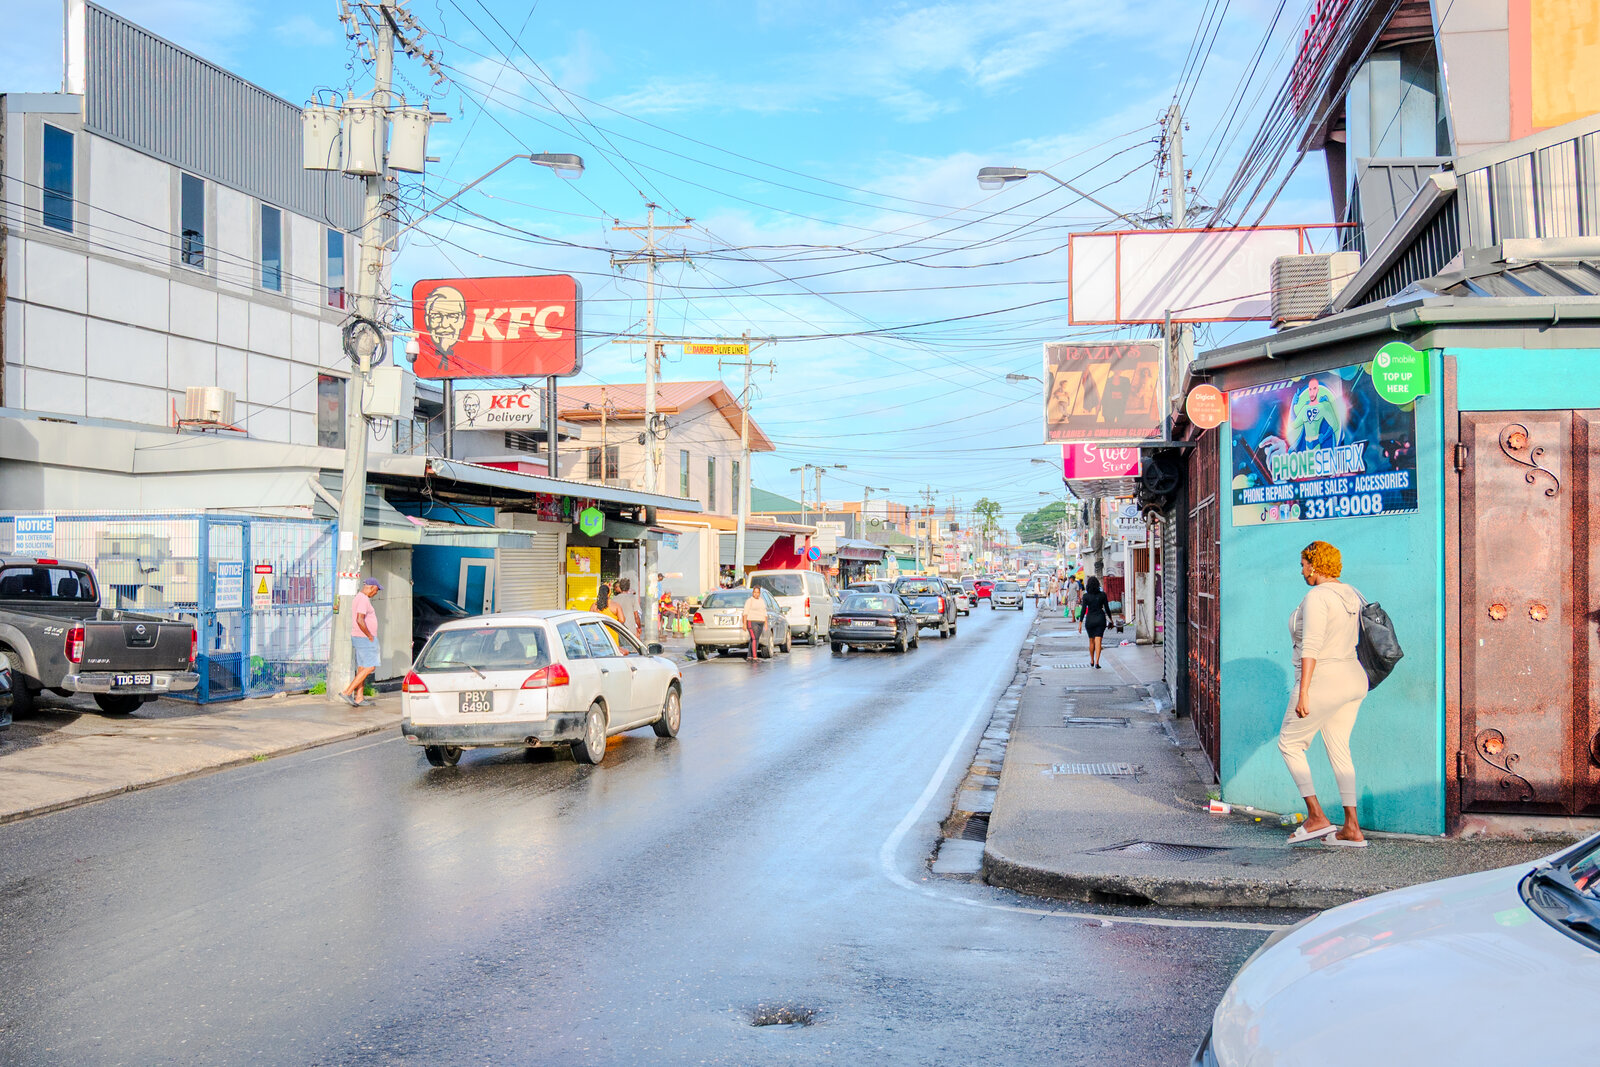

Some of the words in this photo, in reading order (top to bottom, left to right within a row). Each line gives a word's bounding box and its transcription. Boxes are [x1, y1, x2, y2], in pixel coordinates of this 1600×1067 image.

[468, 306, 565, 341] KFC
[693, 346, 714, 354] DANGER
[489, 394, 531, 410] KFC
[487, 412, 533, 424] Delivery
[1102, 462, 1133, 473] Store
[1243, 486, 1265, 503] PHONE
[1265, 484, 1294, 500] REPAIRS
[1299, 481, 1324, 498] PHONE
[1325, 478, 1348, 494] SALES
[1354, 471, 1409, 493] ACCESSORIES
[1305, 494, 1382, 519] 331-9008
[18, 520, 52, 531] NOTICE
[219, 565, 242, 576] NOTICE
[117, 675, 133, 685] TDG
[134, 674, 151, 684] 559
[465, 691, 487, 702] PBY
[462, 702, 490, 712] 6490
